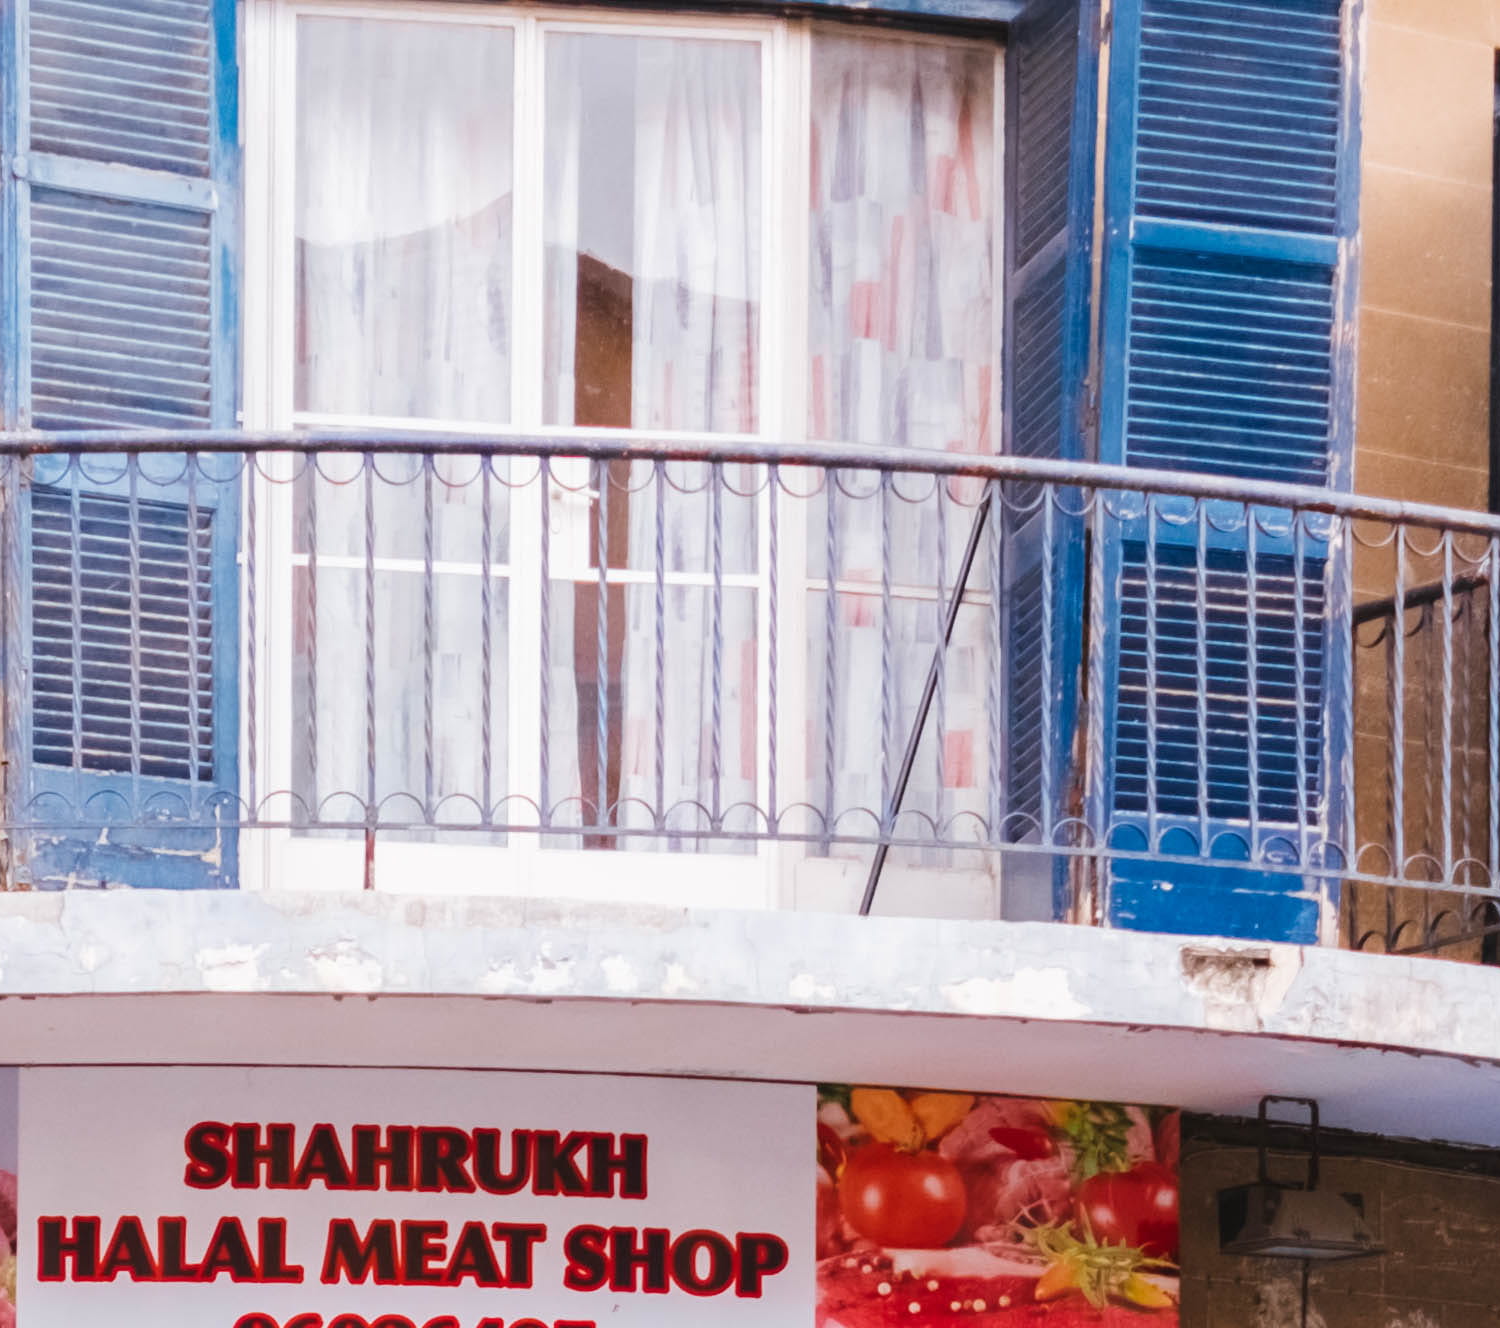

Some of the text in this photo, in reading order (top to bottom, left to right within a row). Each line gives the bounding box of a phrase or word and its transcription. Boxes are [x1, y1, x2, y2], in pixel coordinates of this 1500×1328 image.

[184, 1122, 648, 1199] SHAHRUKH
[37, 1215, 789, 1298] HALAL MEAT SHOP
